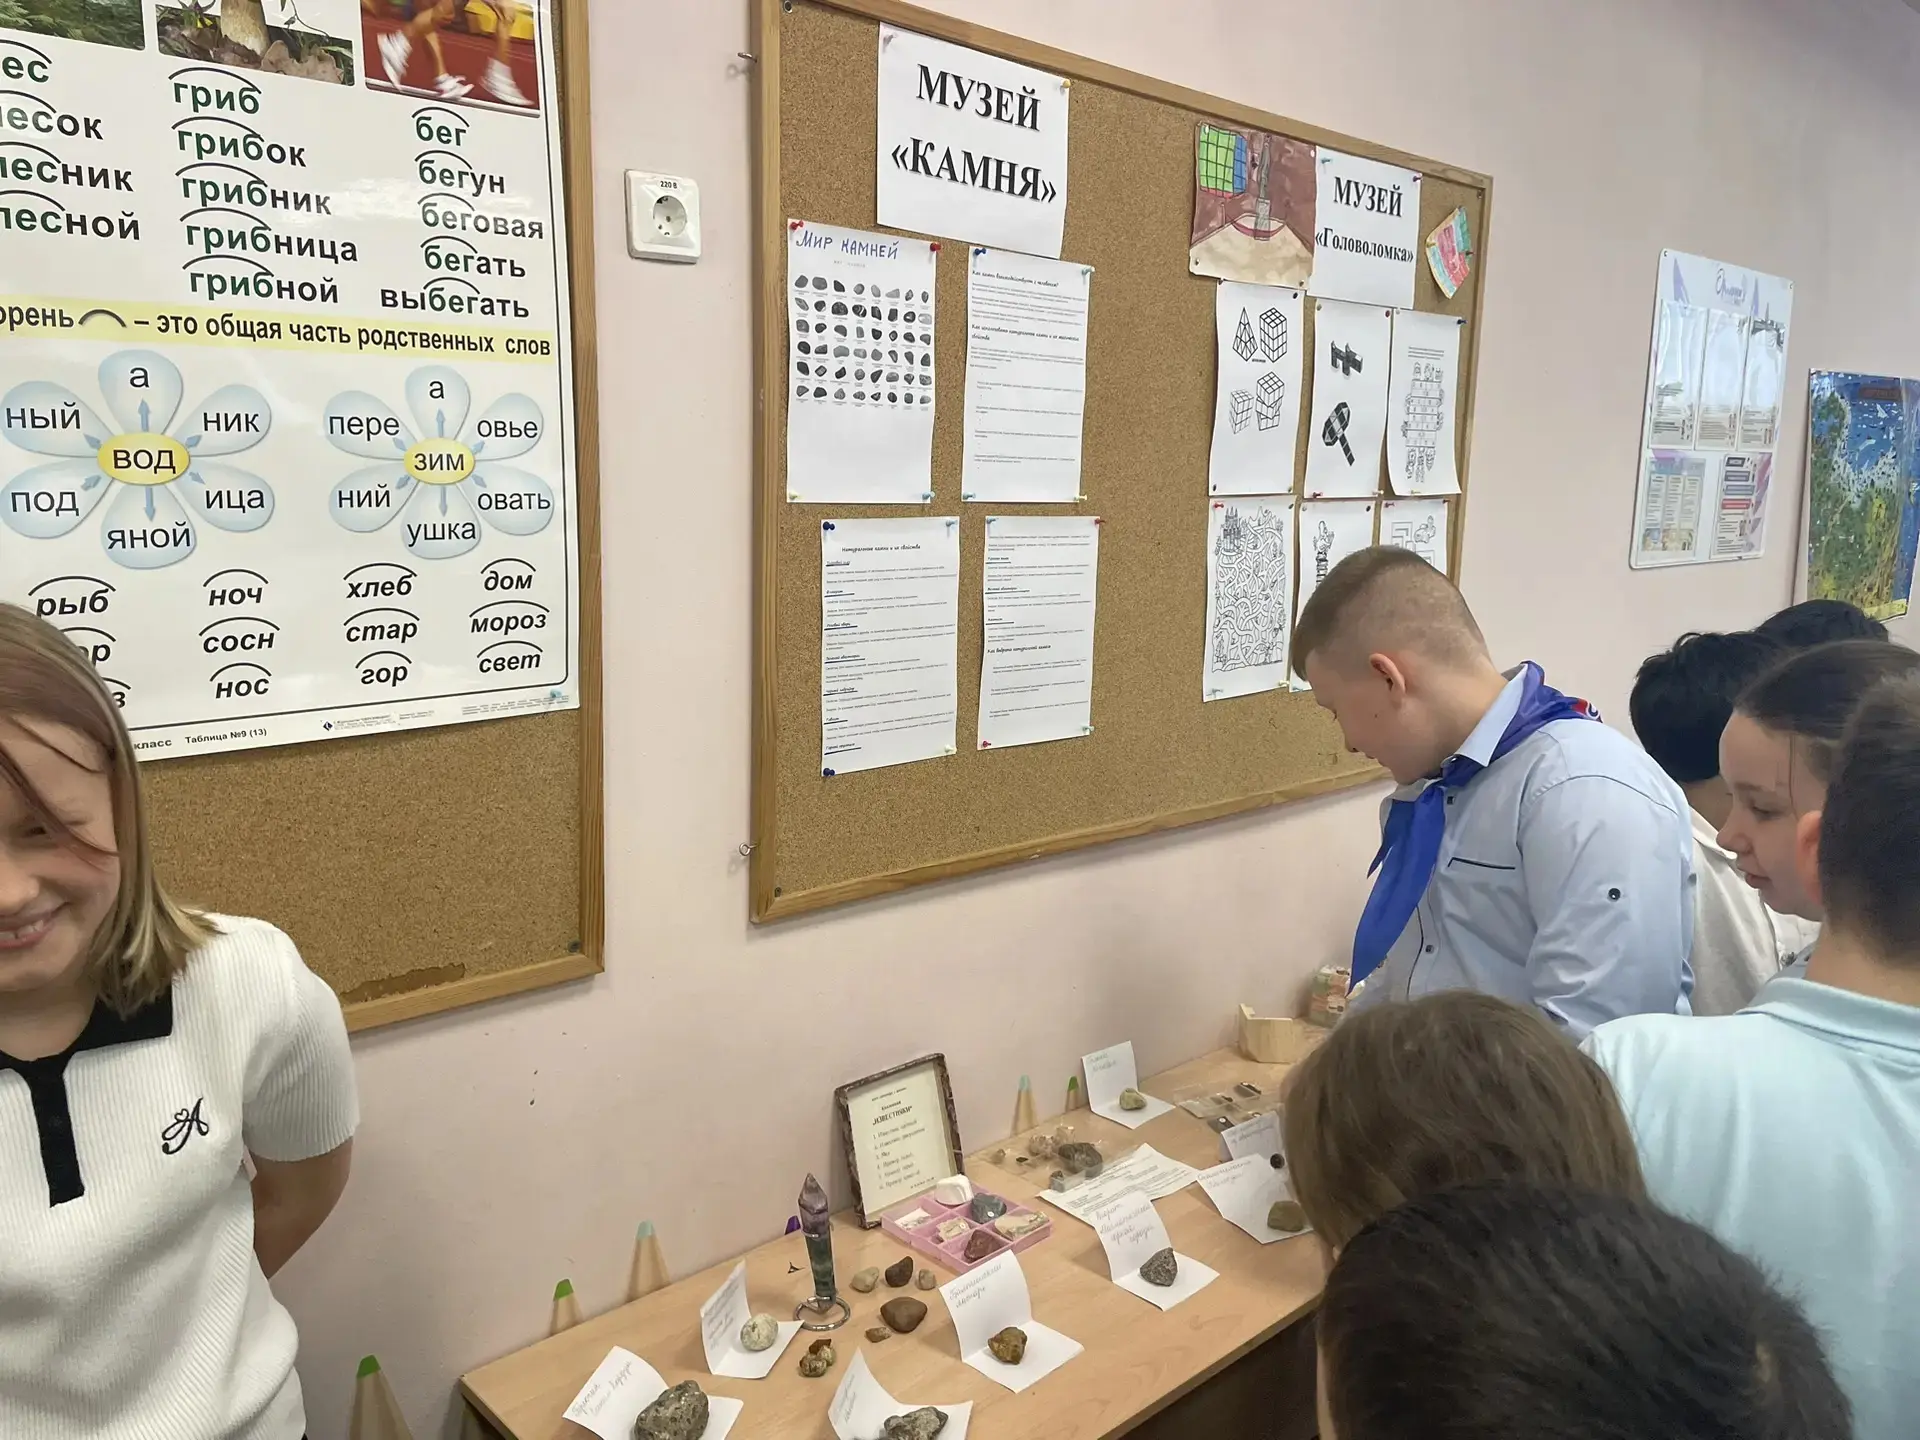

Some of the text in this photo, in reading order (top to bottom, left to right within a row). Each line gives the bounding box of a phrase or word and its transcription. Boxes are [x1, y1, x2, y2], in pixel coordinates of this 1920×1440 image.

[174, 80, 261, 114] гриб
[917, 64, 1040, 131] МУЗЕЙ
[0, 106, 103, 139] есок
[416, 117, 466, 146] бег
[178, 129, 306, 167] грибок
[419, 160, 504, 197] бегун
[892, 138, 1056, 202] «КАМНЯ»
[183, 175, 331, 214] грибник
[660, 180, 672, 188] 220
[1334, 177, 1402, 217] МУЗЕЙ
[422, 203, 543, 239] беговая
[187, 223, 357, 264] грибница
[1316, 228, 1413, 262] «Головоломка»
[425, 245, 525, 277] бегать
[191, 268, 337, 303] грибной
[381, 288, 529, 317] выбегать
[0, 305, 550, 355] рень это общая часть родственных слов
[130, 368, 149, 387] а
[430, 381, 444, 398] а
[7, 402, 80, 429] ный
[204, 413, 259, 432] ник
[330, 417, 399, 441] пере
[478, 420, 537, 438] овье
[114, 450, 176, 474] вод
[415, 453, 464, 470] зим
[11, 492, 79, 516] под
[206, 490, 264, 513] ица
[339, 484, 390, 507] ний
[478, 493, 550, 510] овать
[108, 522, 190, 549] яной
[407, 523, 475, 547] ушка
[347, 574, 413, 598] хлеб
[485, 571, 532, 590] дом
[37, 588, 109, 617] рыб
[209, 588, 262, 605] ноч
[347, 623, 417, 643] стар
[471, 614, 546, 635] мороз
[204, 633, 274, 653] сосн
[480, 654, 540, 673] свет
[216, 673, 269, 698] нос
[361, 666, 407, 687] гор
[134, 728, 267, 750] класс Таблица №9 (13)
